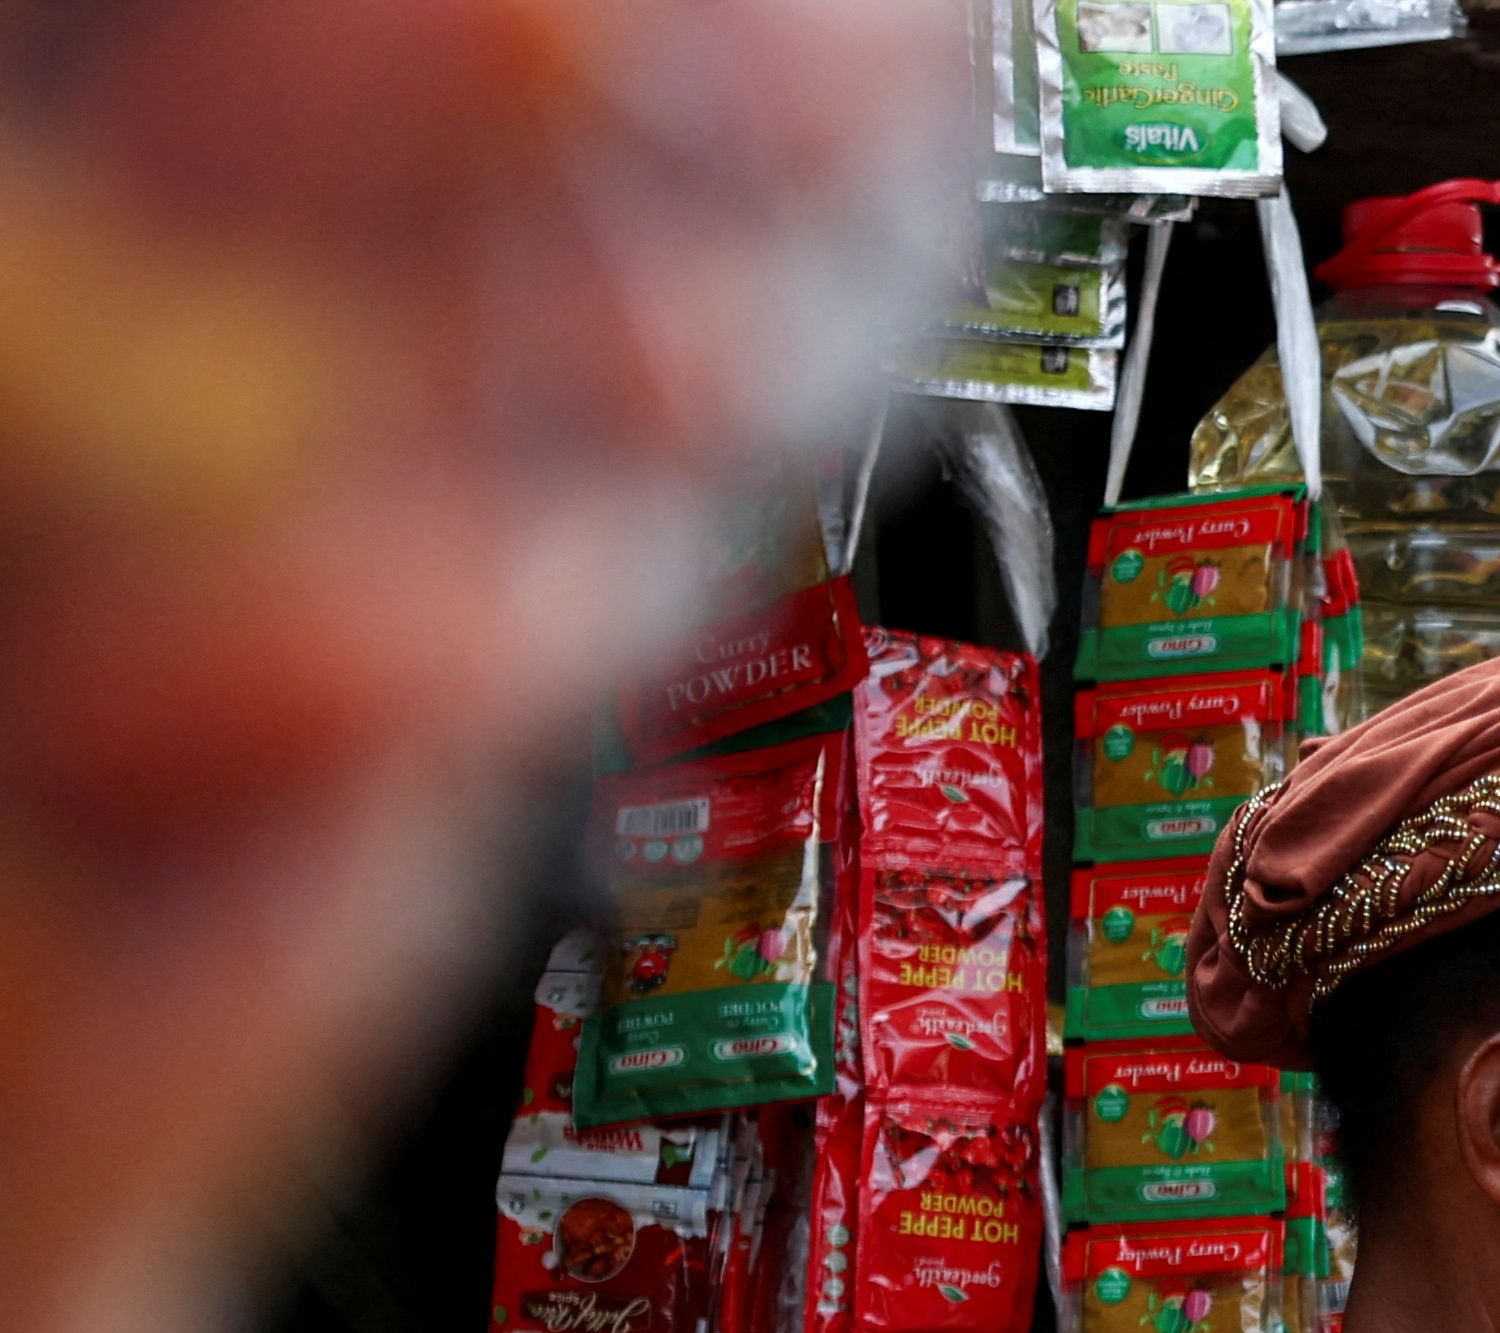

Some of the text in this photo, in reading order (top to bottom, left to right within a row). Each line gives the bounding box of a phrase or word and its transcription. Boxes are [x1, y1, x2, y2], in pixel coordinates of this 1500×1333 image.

[1119, 63, 1179, 82] Paste
[1132, 517, 1250, 550] Curry Powder
[1160, 637, 1203, 656] Gino
[665, 643, 814, 711] POWDER
[1119, 694, 1240, 726] Curry Powder
[968, 722, 1017, 748] HOT
[1159, 818, 1203, 835] Gino
[1119, 884, 1187, 909] Powder
[917, 944, 1007, 967] POWDER
[968, 970, 1025, 994] HOT
[1156, 1000, 1189, 1016] ino
[730, 1037, 778, 1056] Gino
[619, 1050, 668, 1069] Gino
[1113, 1057, 1241, 1087] Curry Powder
[1156, 1184, 1201, 1199] Gino
[918, 1192, 1005, 1218] POWDER
[968, 1219, 1020, 1245] HOT
[1115, 1241, 1242, 1272] Curry Powder
[912, 1259, 1003, 1289] goodearth
